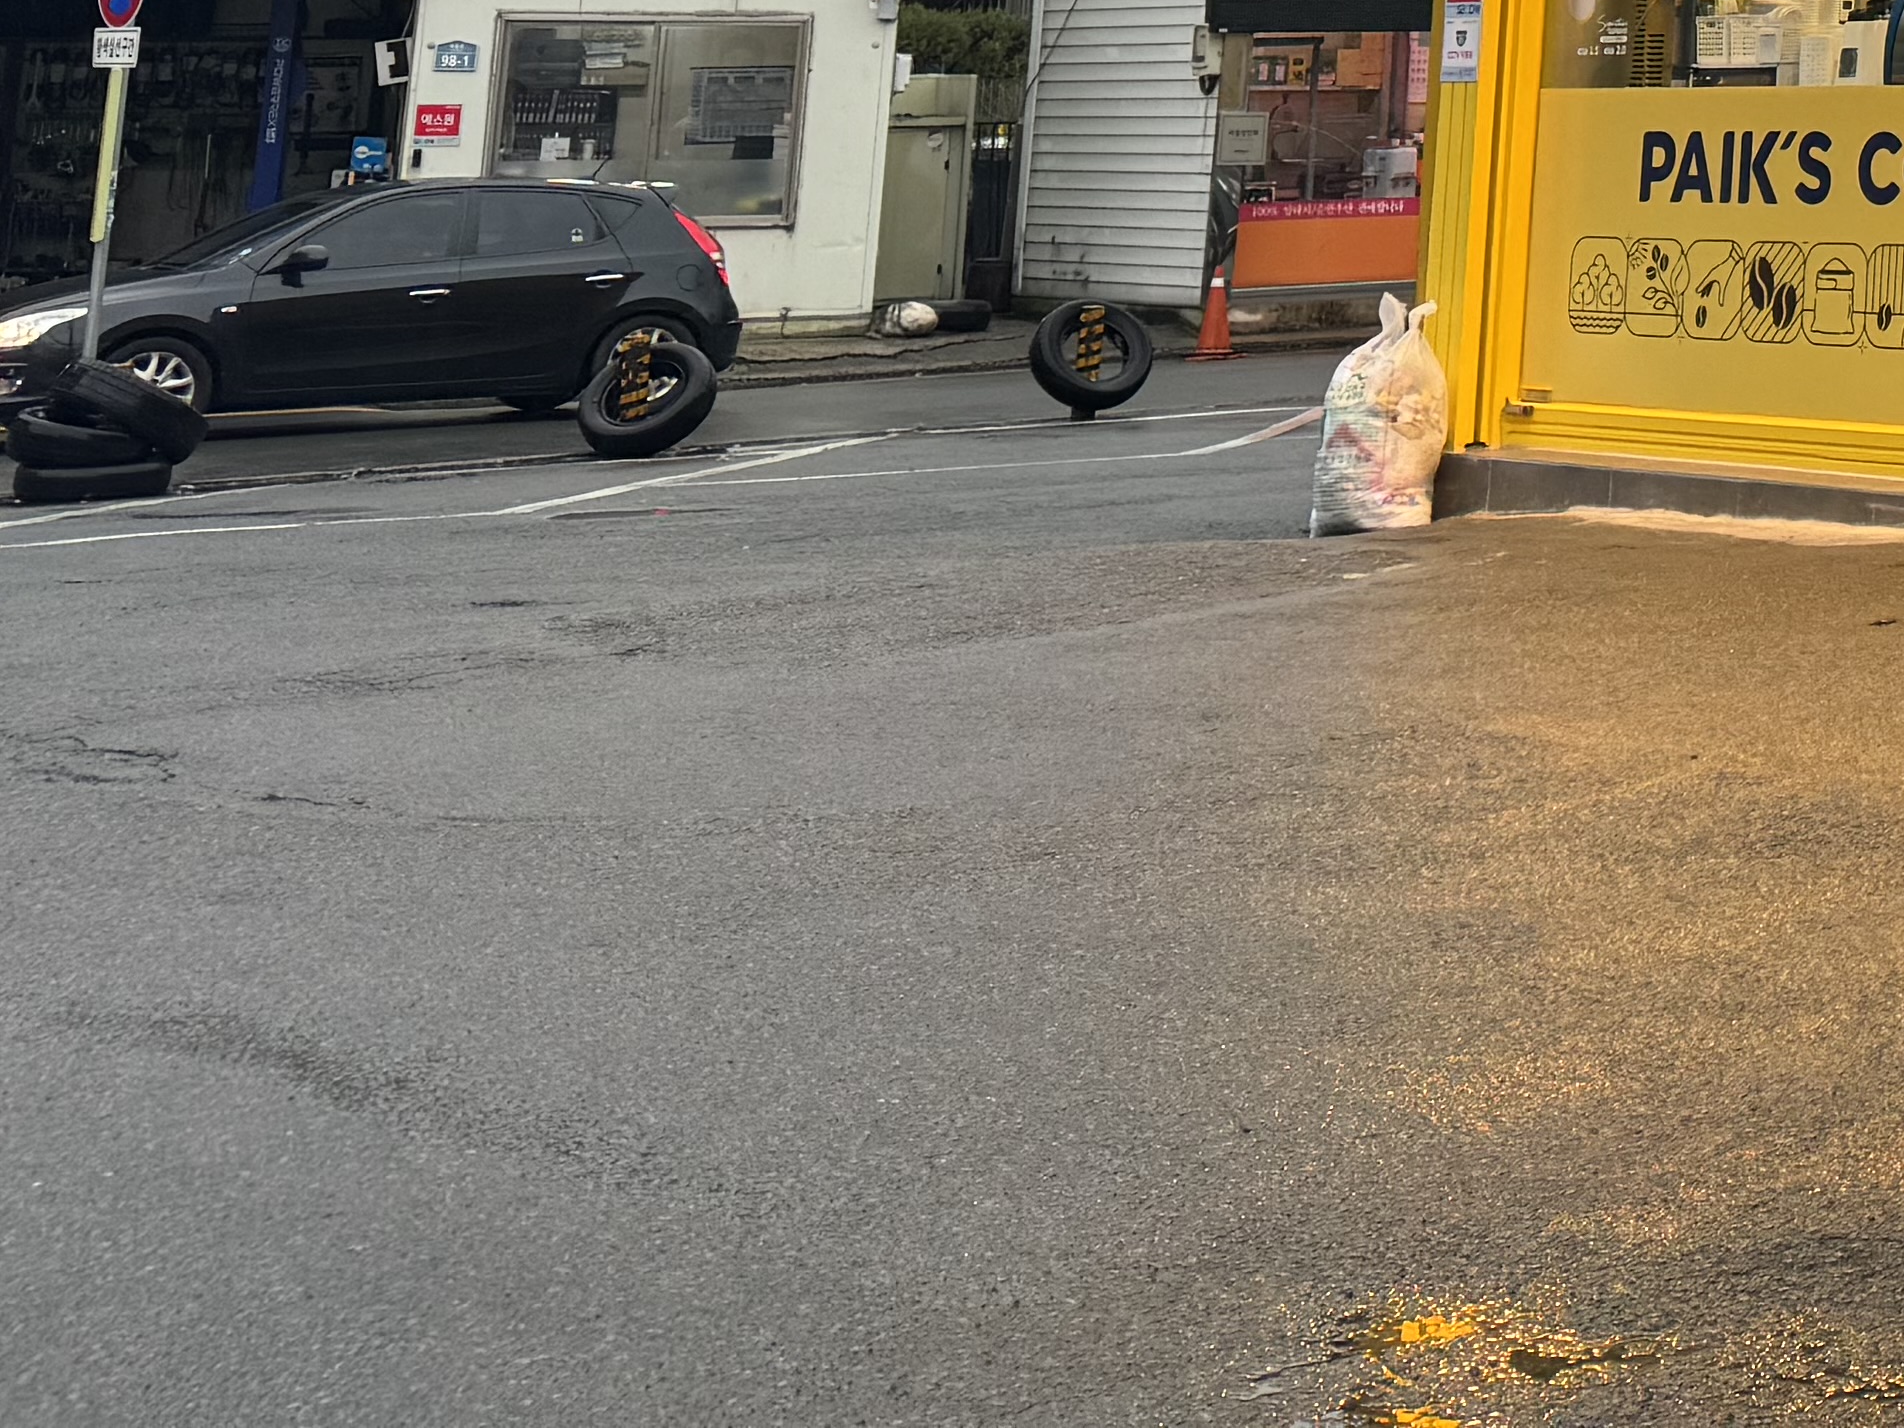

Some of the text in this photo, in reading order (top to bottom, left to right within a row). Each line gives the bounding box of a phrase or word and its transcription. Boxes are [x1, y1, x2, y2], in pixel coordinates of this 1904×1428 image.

[440, 55, 470, 67] 98-1
[420, 113, 455, 126] 에스원
[1638, 130, 1832, 206] PAIK'S
